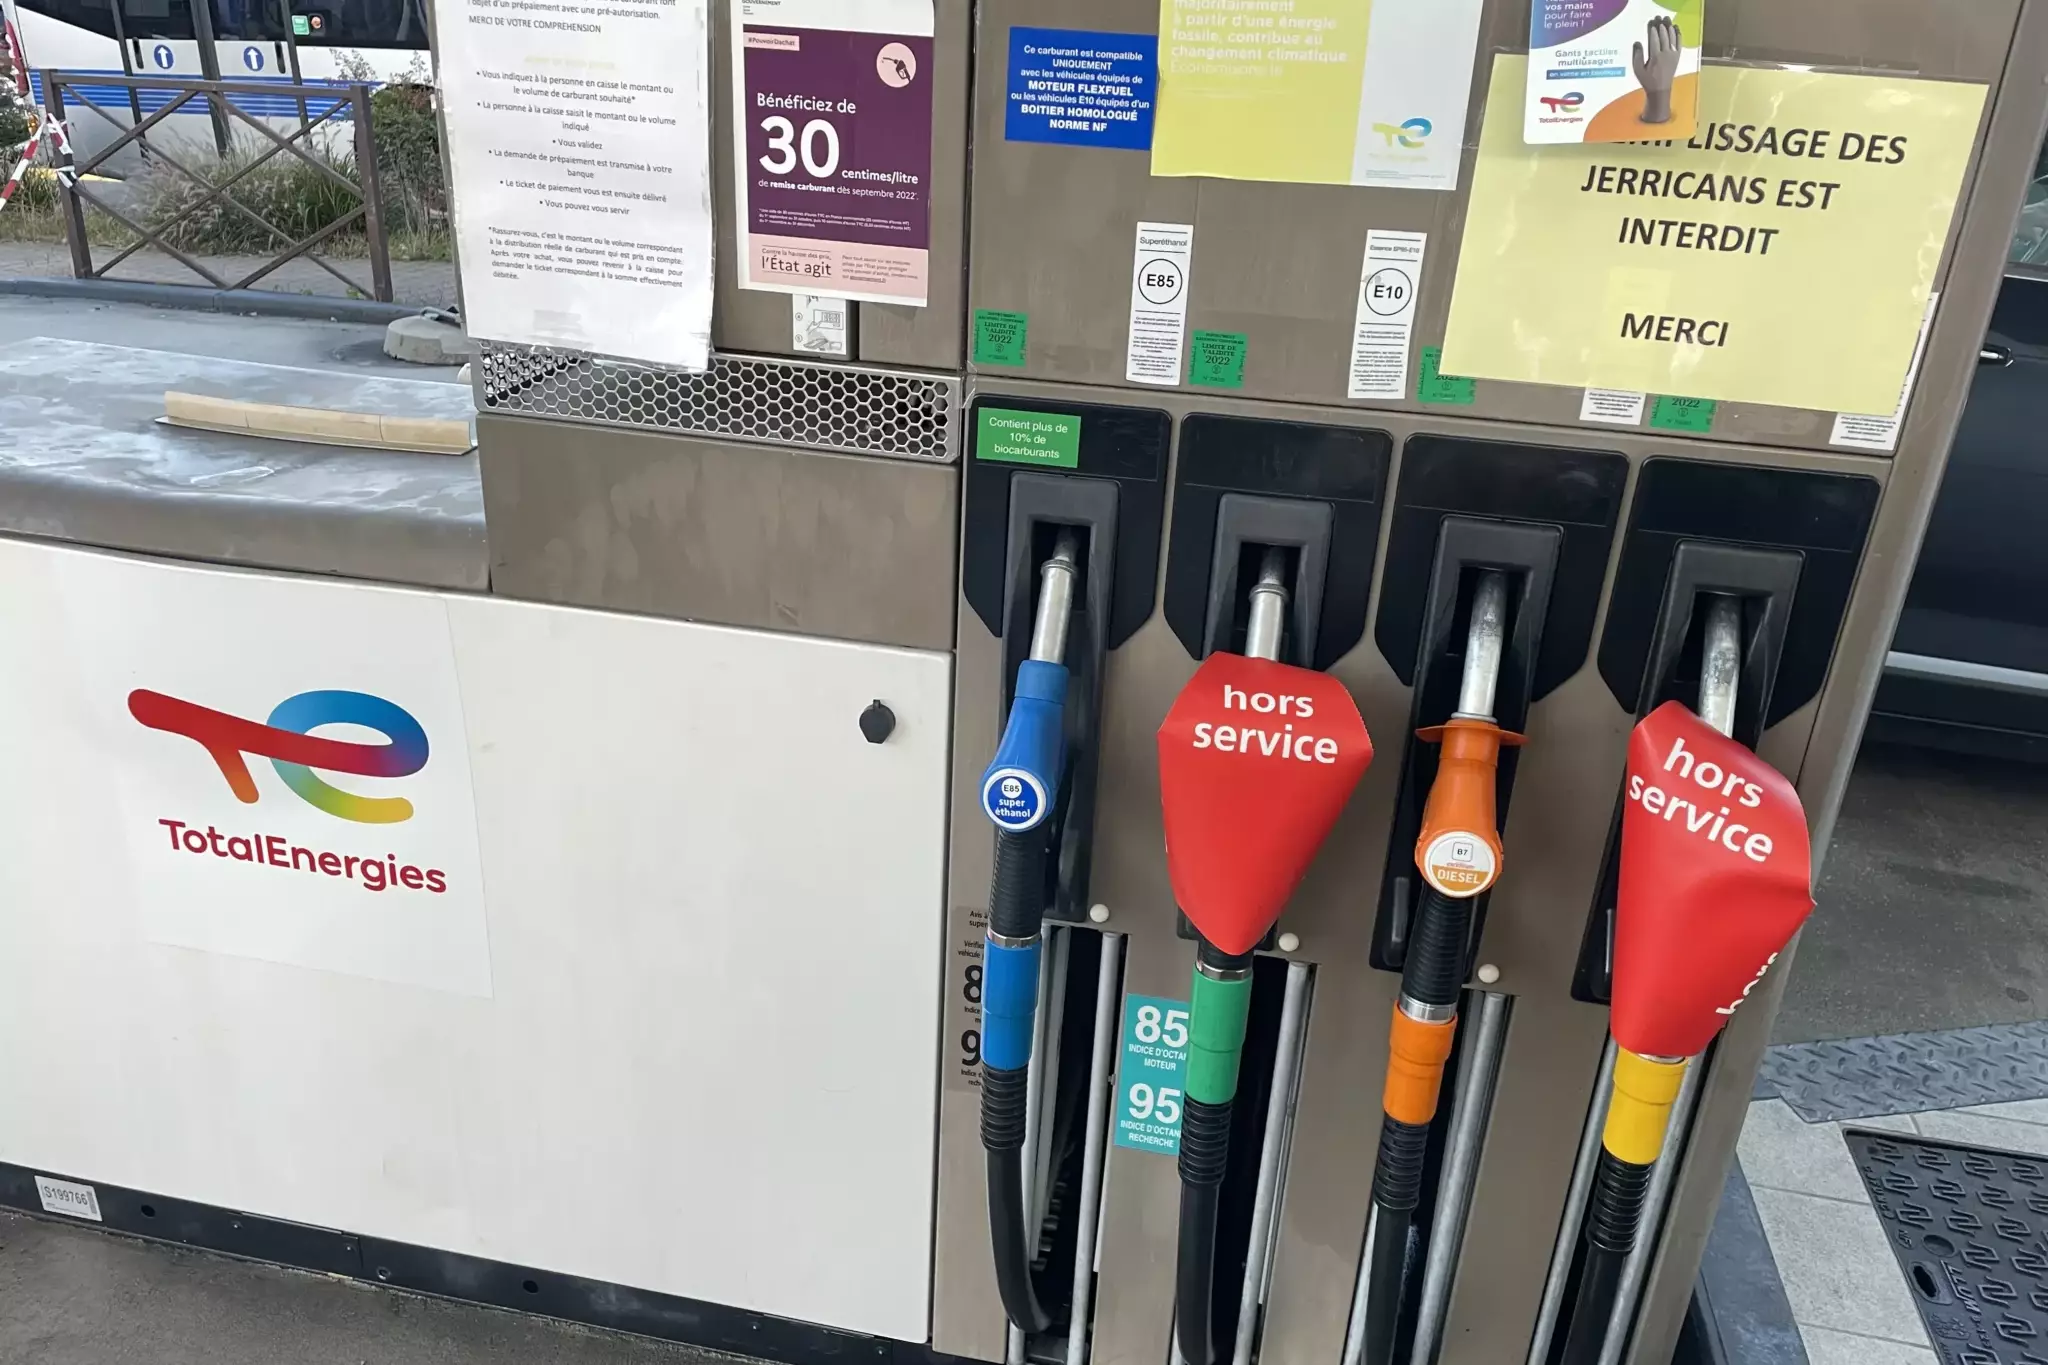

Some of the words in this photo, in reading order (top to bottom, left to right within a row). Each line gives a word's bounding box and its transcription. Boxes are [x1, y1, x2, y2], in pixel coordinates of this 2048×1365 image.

[511, 1, 560, 11] prépaiement
[596, 7, 660, 18] pré-autorisation.
[1564, 2, 1594, 10] mains
[1186, 13, 1227, 28] partir
[1232, 14, 1274, 28] d'une
[1544, 12, 1568, 20] pour
[1570, 10, 1592, 18] faire
[468, 15, 493, 24] MERCI
[494, 16, 504, 26] DE
[506, 18, 532, 28] VOTRE
[533, 20, 601, 33] COMPREHENSION
[1544, 20, 1552, 28] le
[1556, 20, 1578, 28] plein
[1228, 32, 1300, 45] contribue
[1304, 35, 1323, 46] au
[1024, 44, 1036, 54] Ce
[1037, 46, 1078, 56] carburant
[1080, 49, 1094, 57] est
[1095, 51, 1143, 60] compatible
[1172, 45, 1262, 60] changement
[1267, 48, 1348, 64] climatique
[1555, 50, 1581, 58] Gants
[1052, 58, 1112, 70] UNIQUEMENT
[1558, 58, 1614, 66] multiusages
[481, 70, 500, 79] Vous
[501, 72, 533, 82] indiquez
[534, 74, 539, 82] à
[540, 74, 547, 83] la
[549, 77, 584, 86] personne
[596, 81, 619, 89] caisse
[620, 81, 628, 90] le
[628, 83, 662, 92] montant
[1020, 70, 1040, 78] avec
[1042, 70, 1054, 78] les
[1056, 70, 1095, 80] véhicules
[1097, 73, 1130, 84] équipés
[1132, 76, 1143, 84] de
[513, 85, 520, 94] le
[521, 87, 549, 96] volume
[550, 89, 560, 97] de
[561, 91, 598, 100] carburant
[1028, 80, 1075, 92] MOTEUR
[1077, 83, 1133, 96] FLEXFUEL
[757, 92, 832, 112] Bénéficiez
[836, 98, 856, 114] de
[1024, 92, 1036, 101] les
[1038, 94, 1077, 104] véhicules
[1078, 96, 1094, 105] E10
[1096, 98, 1130, 108] équipés
[1130, 100, 1150, 109] d'un
[492, 103, 526, 112] personne
[528, 104, 532, 112] à
[534, 105, 541, 113] la
[542, 107, 564, 115] caisse
[565, 109, 584, 117] saisit
[586, 109, 592, 118] le
[594, 112, 626, 121] montant
[639, 114, 646, 123] le
[648, 116, 676, 125] volume
[1021, 104, 1064, 116] BOITIER
[1067, 107, 1138, 121] HOMOLOGUÉ
[562, 121, 589, 132] indiqué
[1049, 118, 1090, 130] NORME
[1092, 122, 1107, 131] NF
[557, 138, 576, 147] Vous
[577, 140, 602, 150] validez
[759, 115, 839, 178] 30
[1838, 132, 1908, 164] DES
[841, 169, 918, 184] centimes/litre
[758, 179, 768, 187] de
[770, 180, 796, 189] remise
[796, 182, 835, 192] carburant
[836, 186, 850, 194] dès
[852, 188, 894, 198] septembre
[1580, 165, 1767, 204] JERRICANS
[1776, 179, 1840, 210] EST
[544, 199, 563, 208] Vous
[564, 202, 590, 211] pouvez
[1140, 237, 1188, 246] Superéthanol
[1618, 217, 1779, 254] INTERDIT
[762, 255, 800, 272] l'État
[804, 261, 832, 278] agit
[1146, 274, 1174, 288] E85
[1374, 285, 1403, 299] E10
[1620, 313, 1728, 346] MERCI
[988, 334, 1012, 344] 2022
[1205, 355, 1230, 366] 2022
[1672, 397, 1700, 408] 2022
[989, 416, 1030, 430] Contient
[1032, 420, 1052, 433] plus
[1055, 422, 1068, 433] de
[1010, 432, 1031, 443] 10%
[1034, 434, 1046, 444] de
[994, 443, 1059, 458] biocarburants
[1224, 684, 1314, 717] hors
[1192, 722, 1338, 763] service
[1663, 738, 1766, 807] hors
[999, 799, 1025, 808] super
[995, 808, 1030, 817] éthanol
[1629, 775, 1772, 862] service
[158, 818, 446, 893] TotalEnergies
[1437, 870, 1480, 884] DIESEL
[963, 965, 982, 1003] 8
[964, 1006, 980, 1014] Indice
[1135, 1005, 1189, 1048] 85
[961, 1029, 981, 1066] 9
[1129, 1044, 1154, 1055] INDICE
[1144, 1058, 1176, 1071] MOTEUR
[961, 1069, 976, 1077] Indice
[1129, 1083, 1181, 1124] 95
[1120, 1120, 1145, 1131] INDICE
[1128, 1133, 1174, 1148] RECHERCHE
[44, 1186, 88, 1205] S199766
